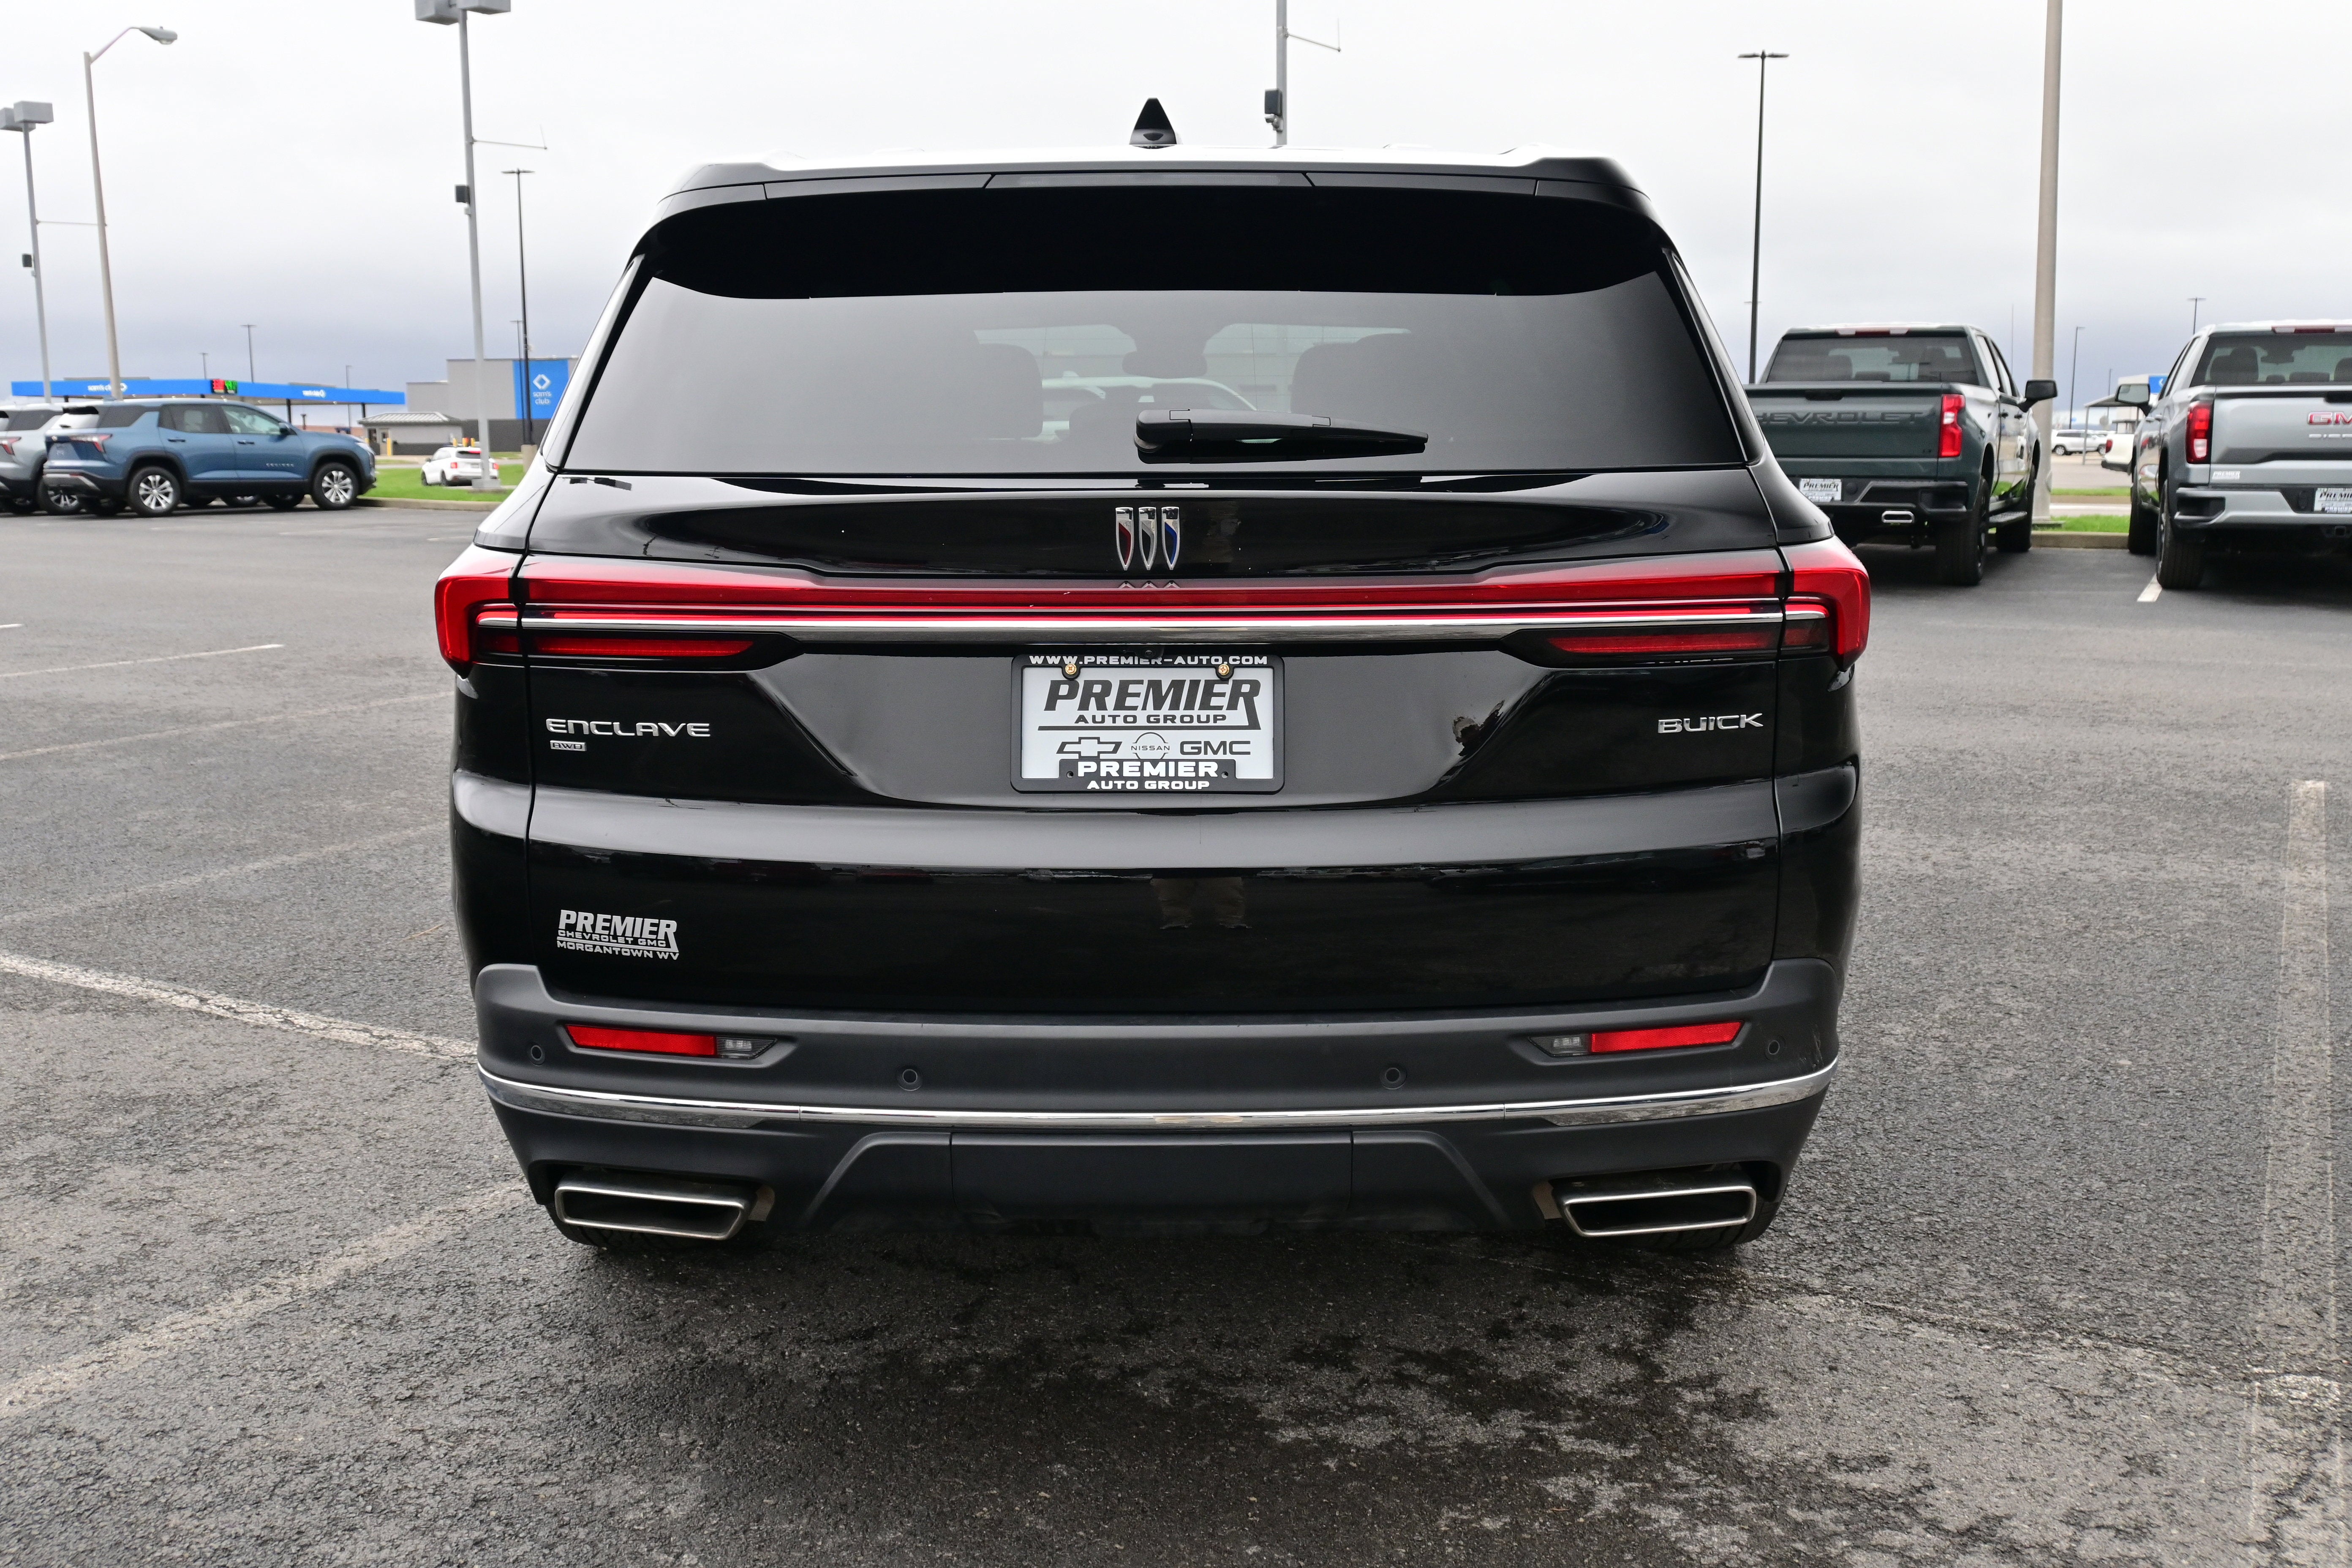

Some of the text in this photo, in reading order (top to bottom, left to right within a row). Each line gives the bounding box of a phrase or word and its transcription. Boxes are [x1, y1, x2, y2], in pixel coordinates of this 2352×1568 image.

[1756, 411, 1923, 423] HEVROLET
[2308, 412, 2352, 425] GM
[1029, 656, 1268, 664] WWW.PREMIER-AUTO.COM
[1044, 679, 1261, 711] PREMIER
[1075, 714, 1227, 724] AUTO GROUP
[1658, 713, 1764, 734] BUICK
[546, 718, 710, 737] ENCLAVE
[1179, 740, 1251, 755] GMC
[1078, 761, 1218, 777] PREMIER
[1087, 780, 1210, 789] AUTO GROUP
[558, 909, 677, 940] PREMIER
[558, 930, 666, 947] CHEVROLET GMC
[557, 941, 679, 960] MORGANTOWN WV
